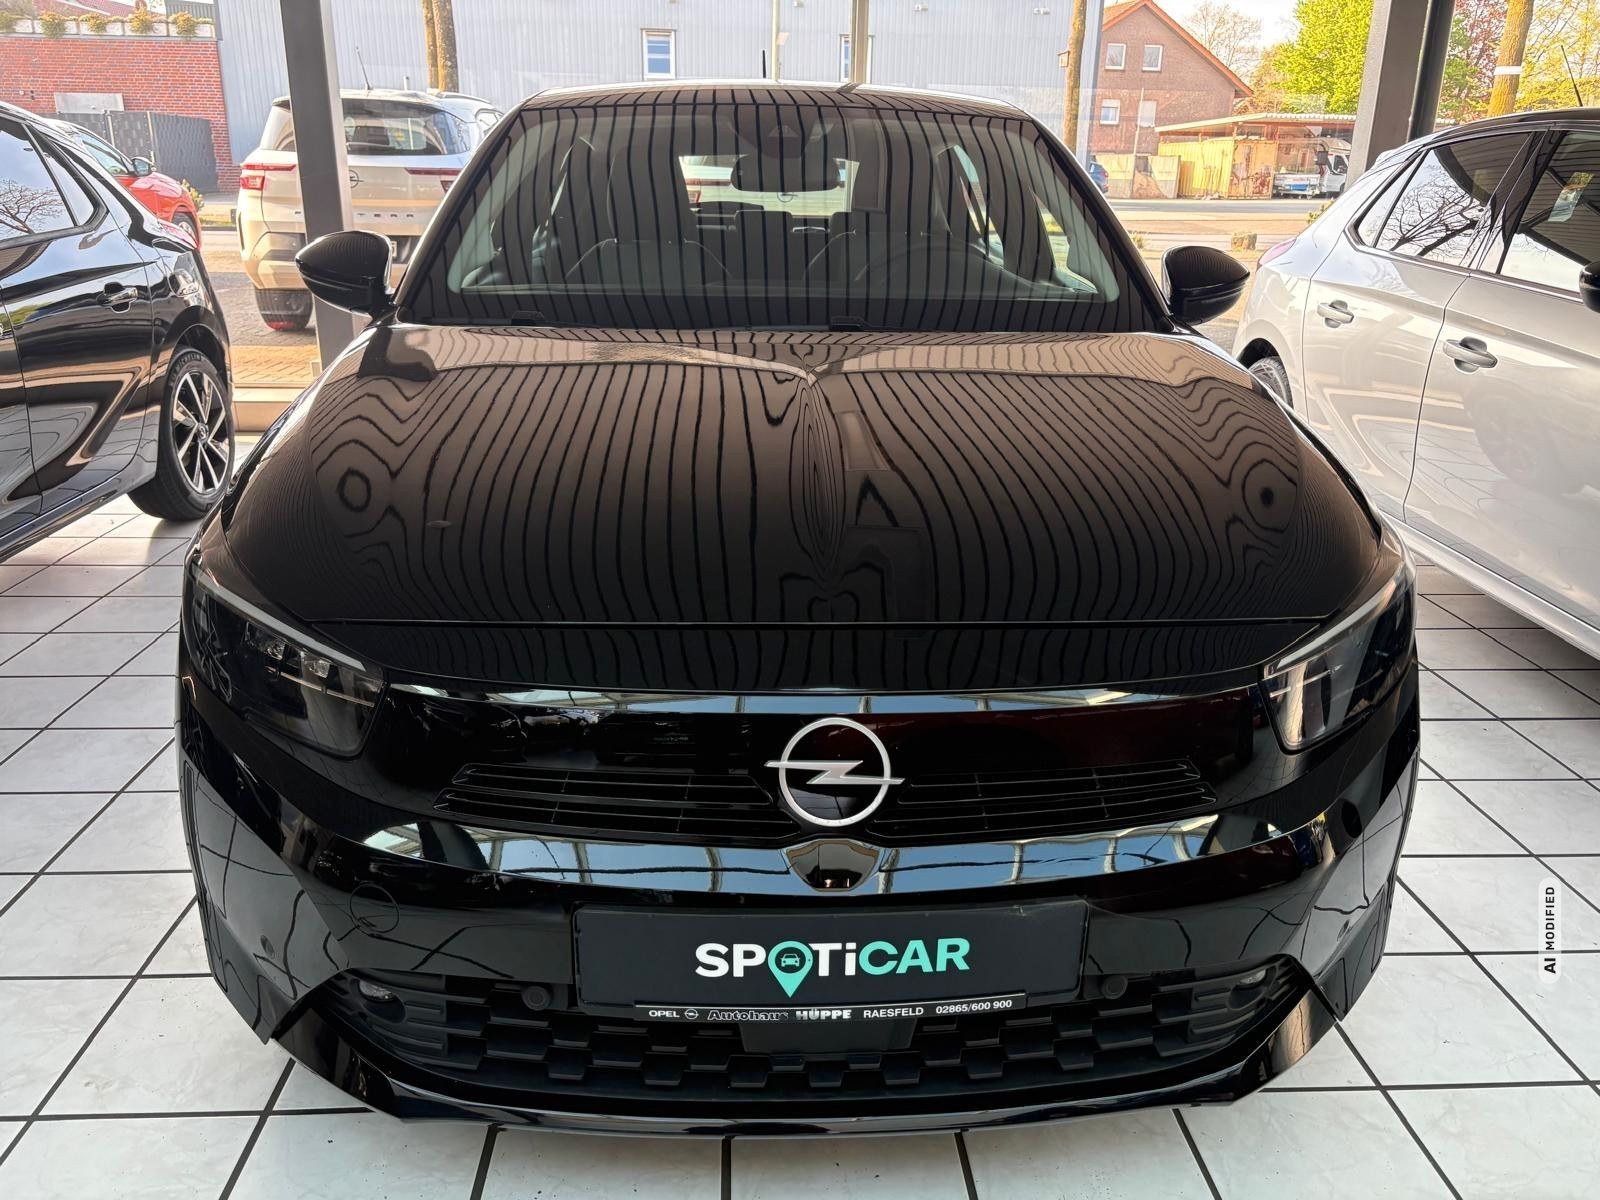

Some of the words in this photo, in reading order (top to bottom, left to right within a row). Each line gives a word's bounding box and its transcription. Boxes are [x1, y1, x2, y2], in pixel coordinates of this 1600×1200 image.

[648, 1009, 680, 1018] OPEL
[795, 1008, 852, 1020] HÜPPE
[863, 1006, 924, 1018] RAESFELD
[935, 1001, 991, 1015] 02865/600
[992, 999, 1013, 1009] 900
